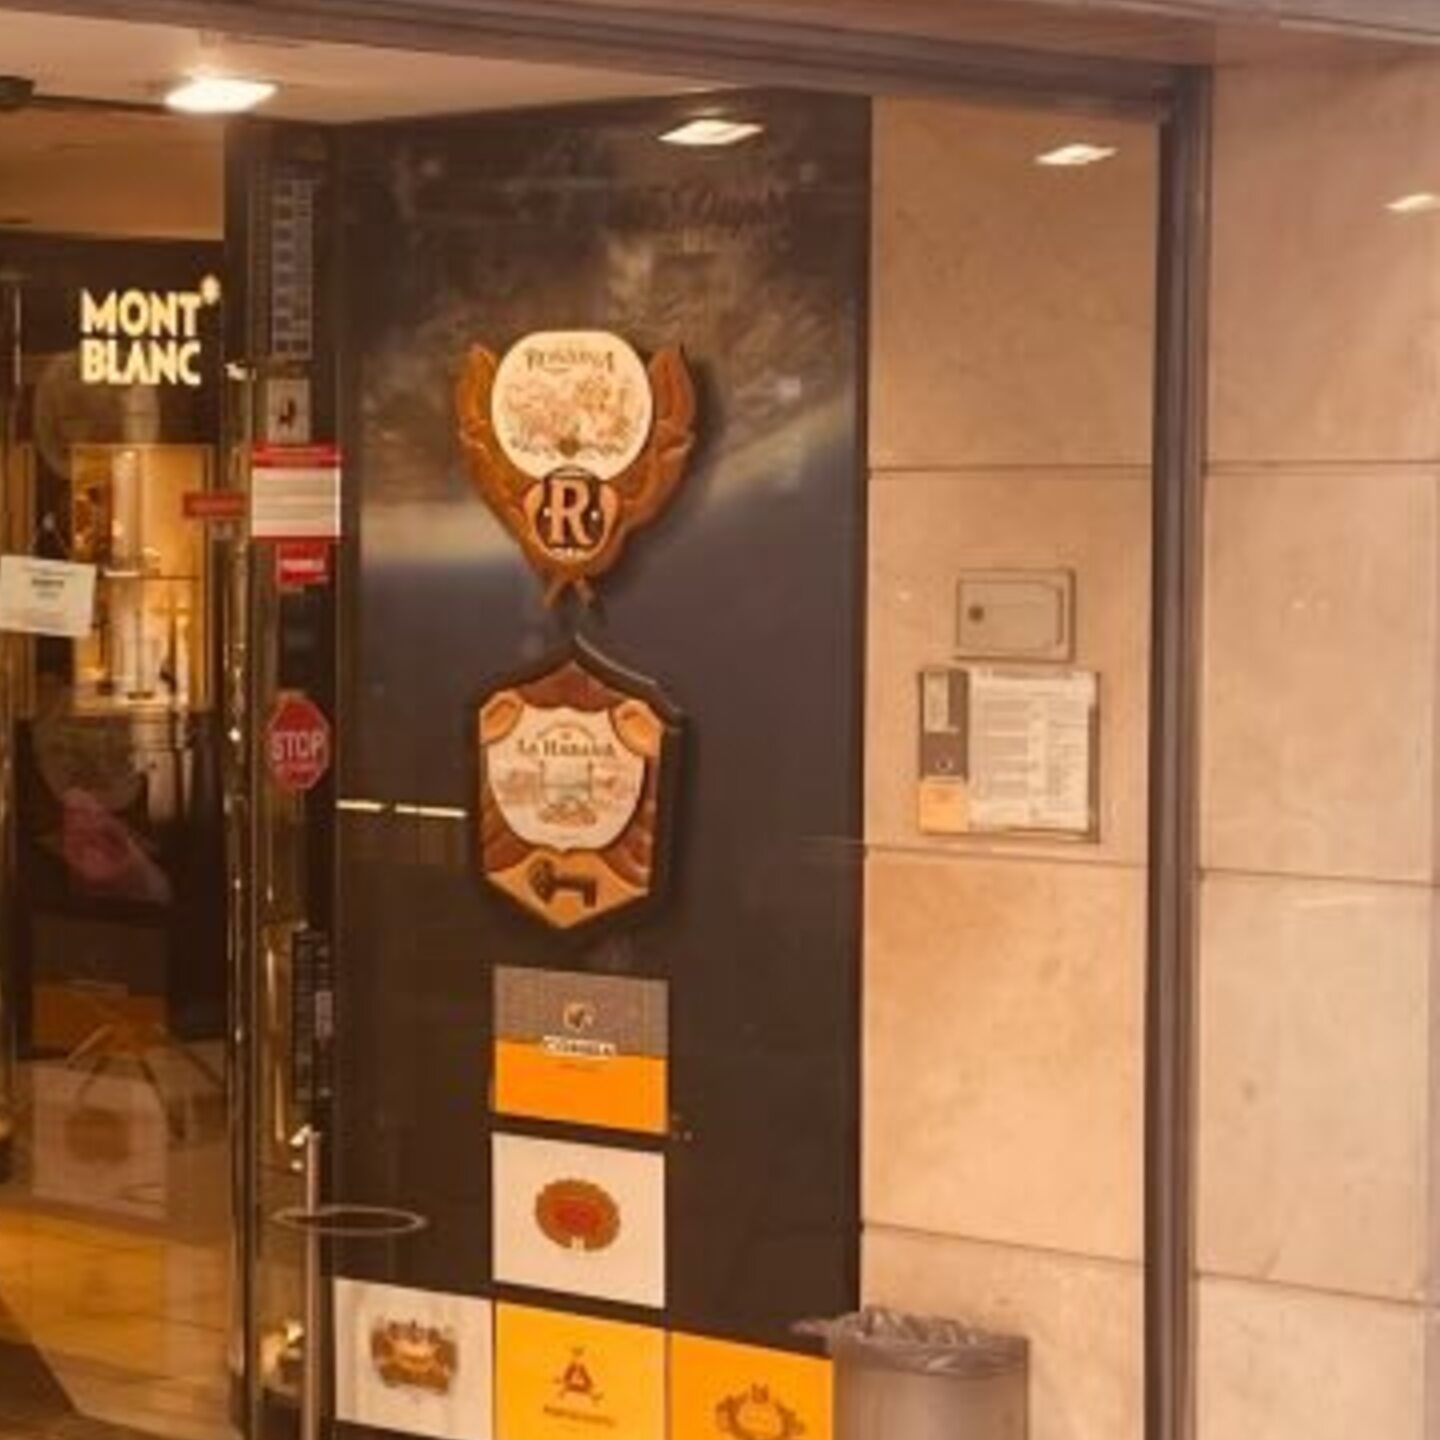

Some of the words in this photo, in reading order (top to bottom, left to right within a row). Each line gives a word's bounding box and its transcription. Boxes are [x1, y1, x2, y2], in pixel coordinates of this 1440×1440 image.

[81, 290, 202, 337] MONT
[81, 339, 202, 386] BLANC
[271, 730, 326, 761] STOP
